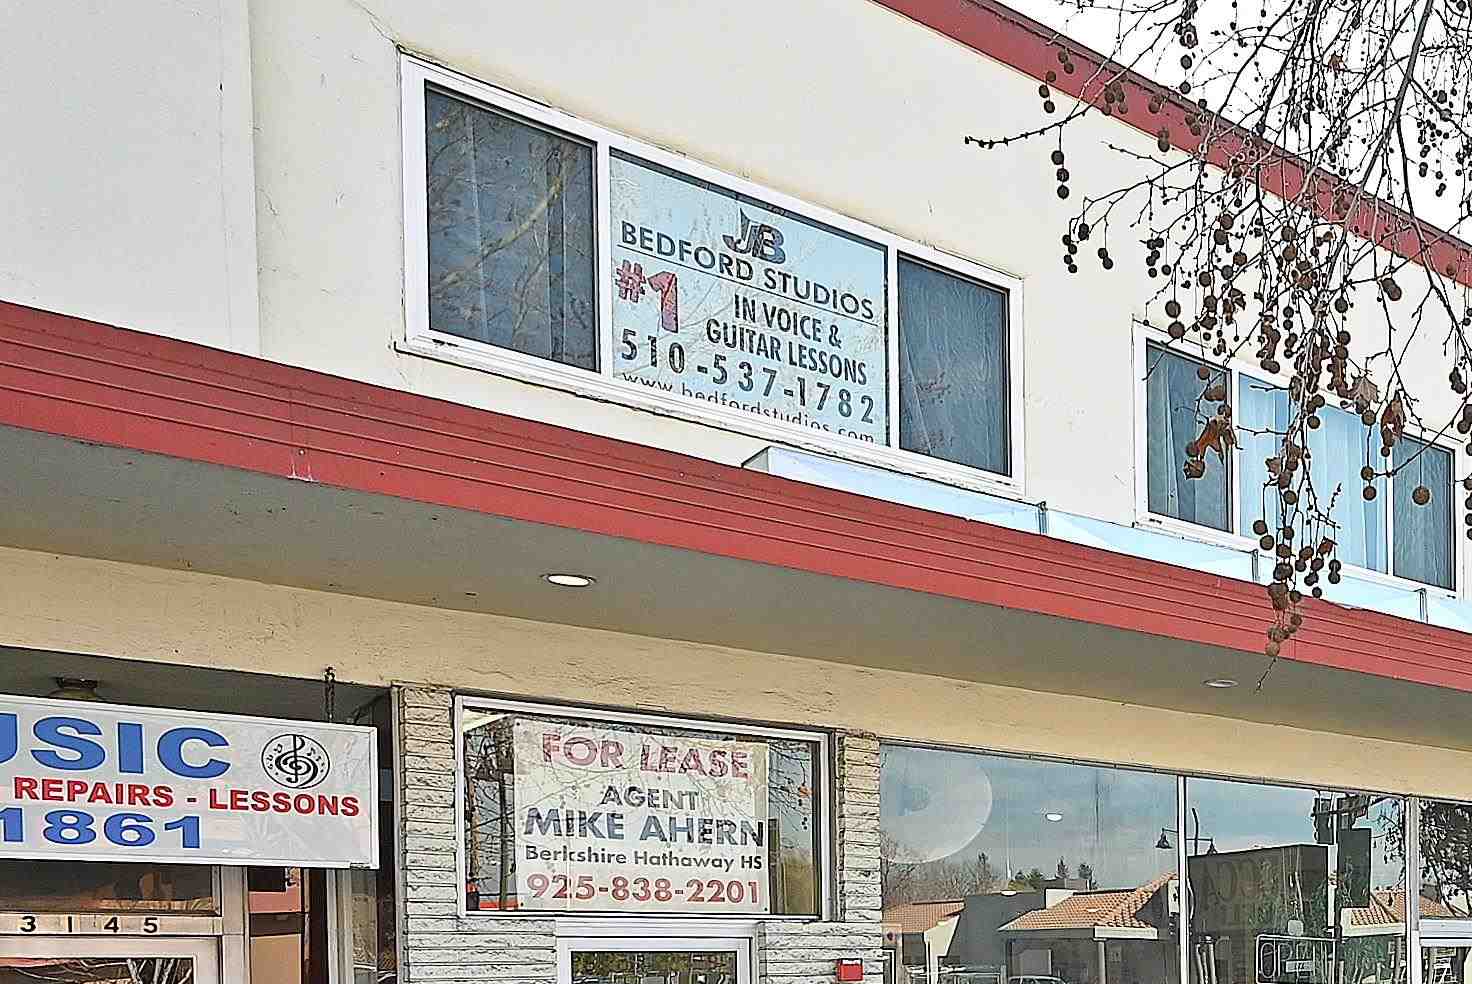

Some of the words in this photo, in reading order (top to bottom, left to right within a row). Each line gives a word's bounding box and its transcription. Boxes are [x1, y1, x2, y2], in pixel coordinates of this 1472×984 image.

[621, 221, 754, 281] BEDFORD
[764, 268, 874, 319] STUDIOS
[615, 259, 680, 333] #1
[733, 294, 756, 323] IN
[763, 302, 822, 343] VOICE
[828, 324, 842, 349] &
[706, 319, 782, 362] GUITAR
[788, 341, 867, 386] LESSONS
[0, 713, 231, 778] SIC
[542, 733, 625, 770] FOR
[640, 743, 752, 781] LEASE
[14, 776, 174, 808] REPAIRS
[209, 788, 360, 817] LESSONS
[600, 785, 700, 811] AGENT
[524, 807, 625, 842] MIKE
[640, 814, 765, 848] AHERN
[525, 845, 627, 865] Berkshire
[635, 850, 735, 872] Hathaway
[741, 855, 762, 870] HS
[527, 873, 760, 906] 925-838-2201
